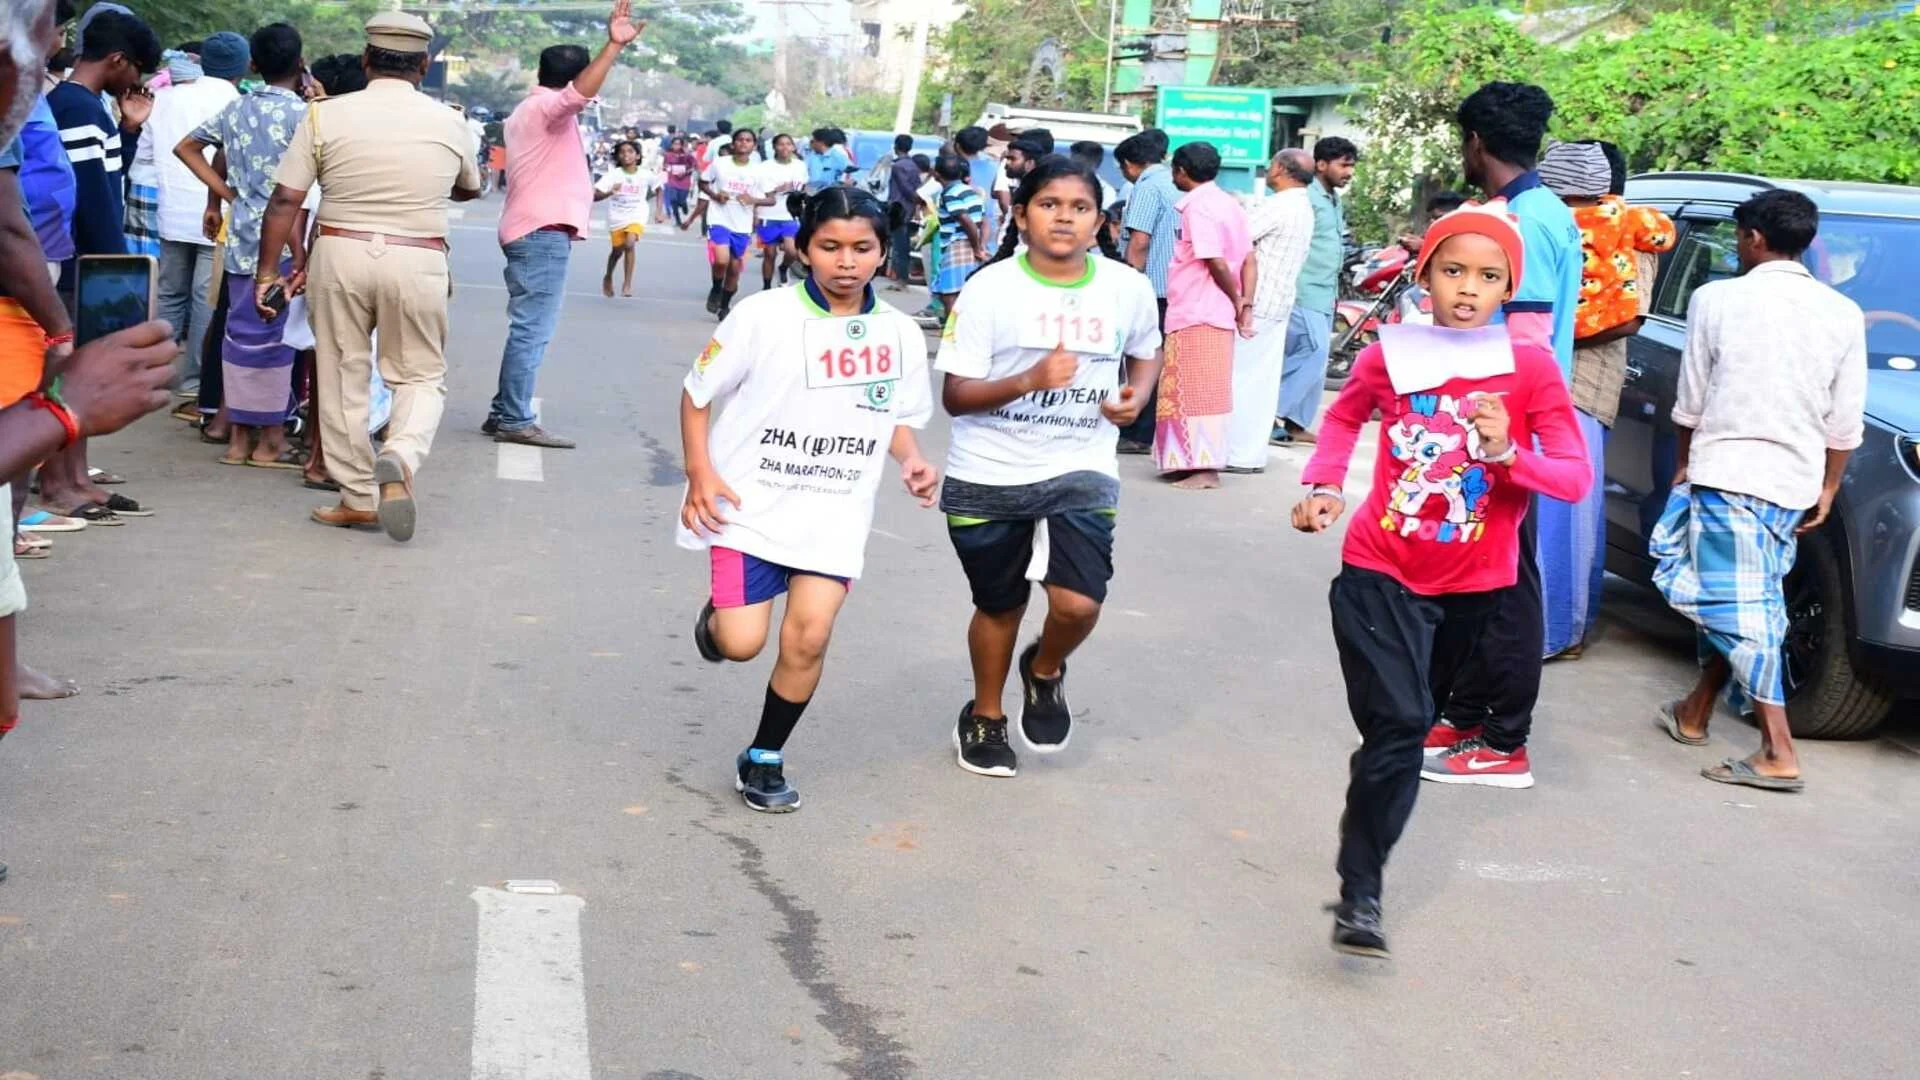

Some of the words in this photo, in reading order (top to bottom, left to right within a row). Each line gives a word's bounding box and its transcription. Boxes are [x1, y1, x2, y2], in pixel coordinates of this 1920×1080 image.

[1036, 311, 1105, 344] 1113
[819, 345, 893, 379] 1618
[1409, 393, 1481, 417] WAN
[760, 428, 797, 449] ZHA
[759, 457, 781, 473] ZHA
[784, 463, 862, 481] MARATHON-20
